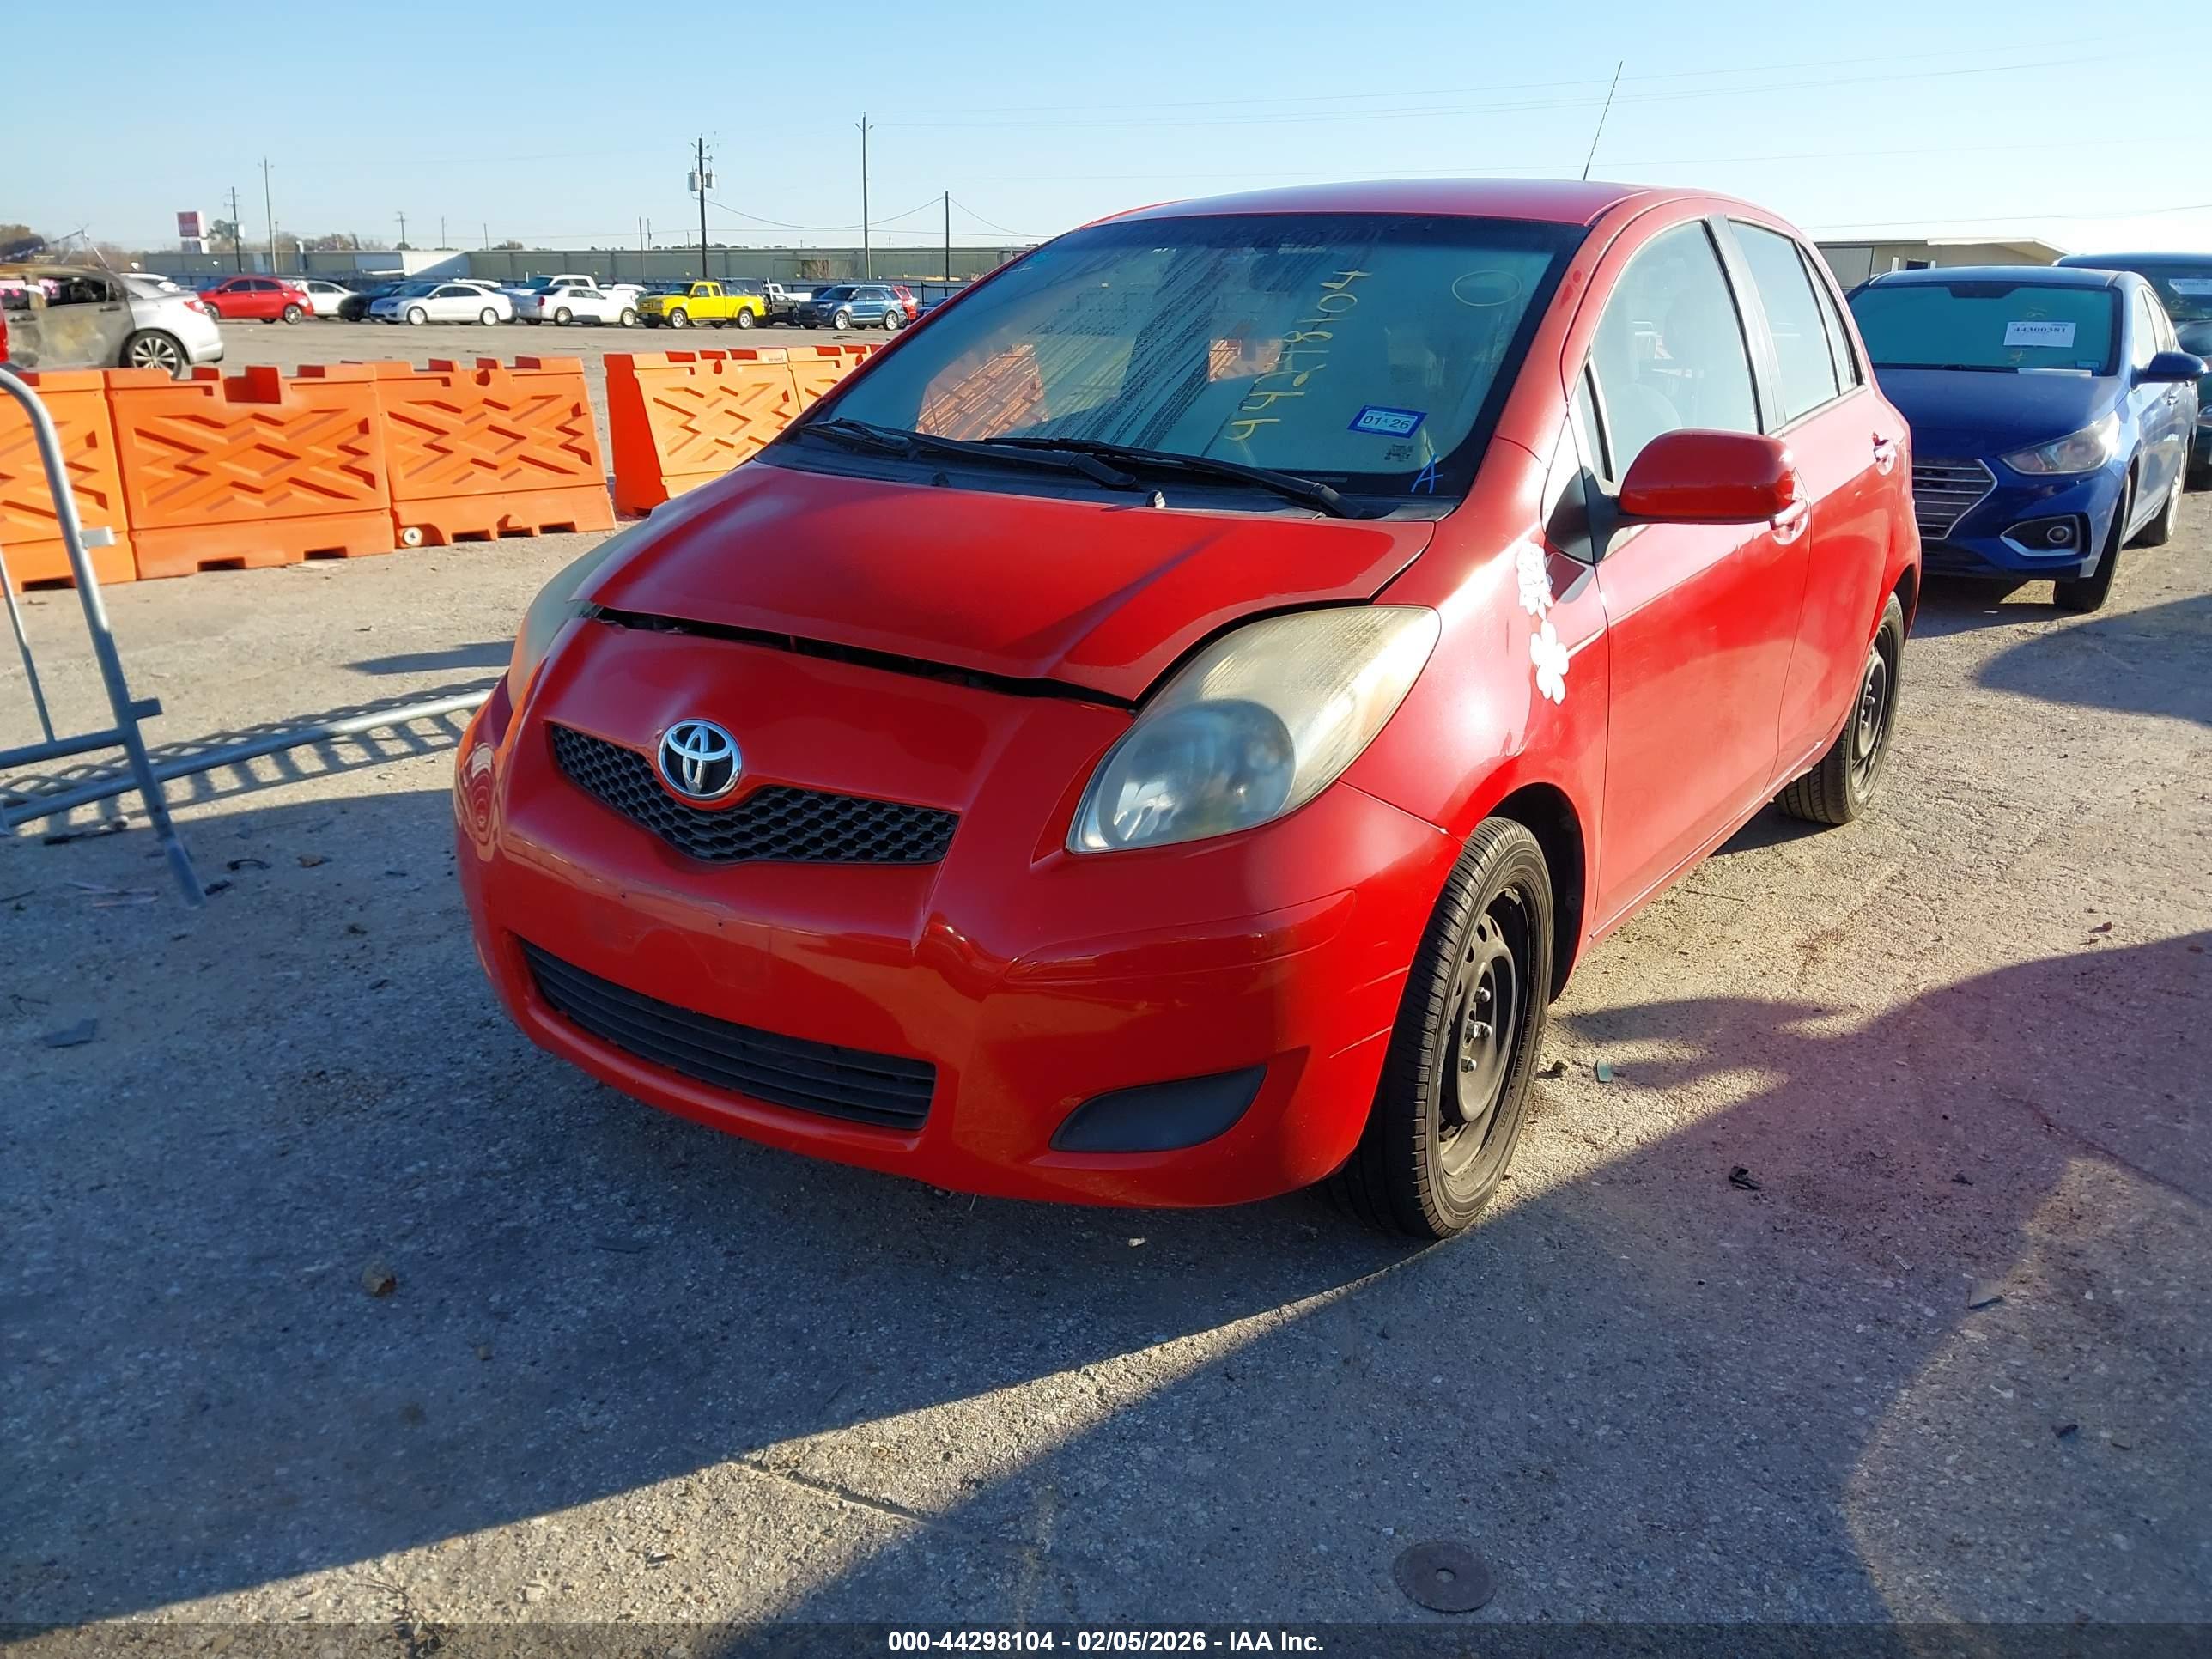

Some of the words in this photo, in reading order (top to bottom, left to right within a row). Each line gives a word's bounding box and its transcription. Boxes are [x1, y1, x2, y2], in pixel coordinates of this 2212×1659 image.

[1363, 415, 1382, 426] 01
[1389, 418, 1410, 429] 26
[1410, 453, 1443, 494] A
